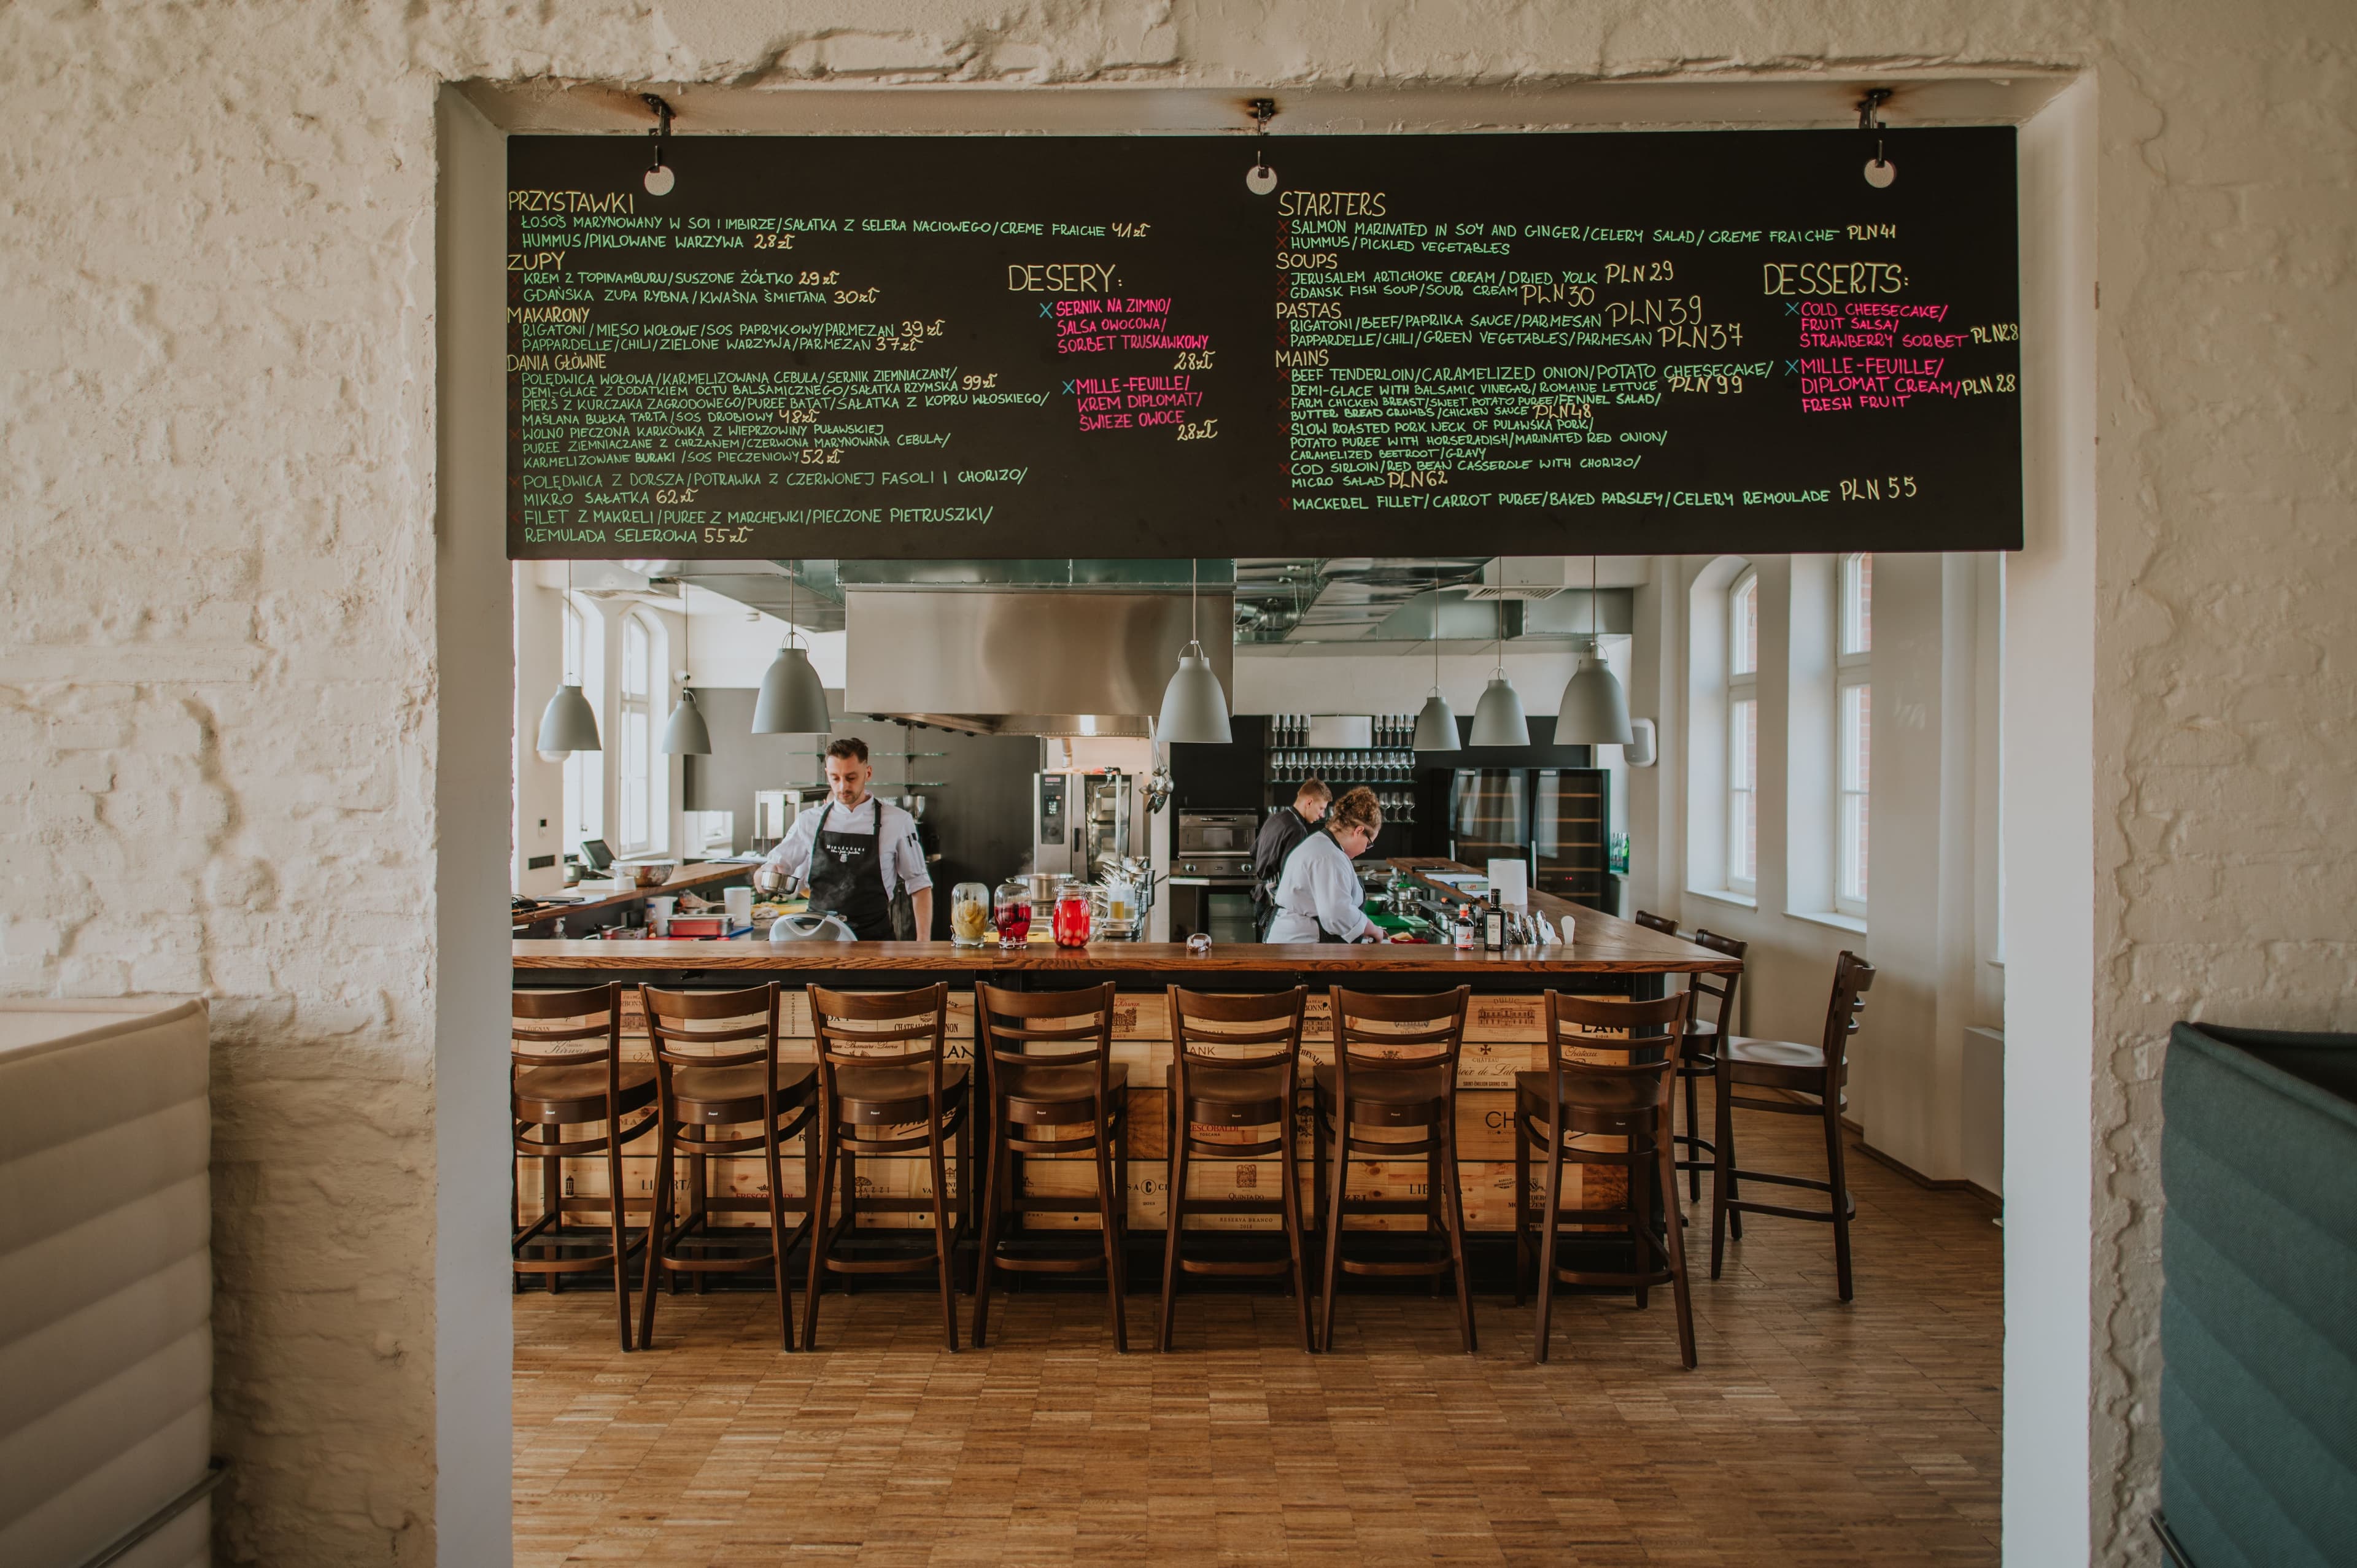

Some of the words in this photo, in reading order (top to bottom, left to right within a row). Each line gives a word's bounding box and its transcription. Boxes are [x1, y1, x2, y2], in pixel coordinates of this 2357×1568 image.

[509, 190, 633, 214] PRZYSTAWKI
[1279, 191, 1385, 216] STARTERS
[574, 216, 662, 228] MARYNOWANY
[670, 218, 679, 229] W
[688, 218, 710, 229] SOI
[718, 220, 719, 228] I
[844, 220, 854, 231] Z
[862, 219, 906, 231] SELERA
[1053, 224, 1105, 236] FRAICHE
[1292, 220, 1345, 234] SALMON
[1355, 223, 1426, 236] MARINATED
[1436, 224, 1447, 236] IN
[1456, 224, 1483, 235] SOY
[1492, 225, 1516, 236] AND
[1770, 230, 1839, 242] FRAICHE
[676, 236, 743, 248] WARZYWA
[1422, 242, 1509, 255] VEGETABLES
[506, 251, 565, 271] ZUPY
[1277, 252, 1337, 269] SOUPS
[524, 272, 559, 284] KREM
[741, 269, 793, 284] ŻÓŁTKO
[1008, 264, 1122, 292] DESERY:
[1291, 271, 1365, 285] JERUSALEM
[1374, 271, 1442, 282] ARTICHOKE
[1563, 271, 1597, 284] YOLK
[1764, 262, 1908, 295] DESSERTS:
[524, 287, 594, 301] GDAŃSKA
[605, 290, 637, 301] ZUPA
[765, 290, 826, 303] ŚMIETANA
[1291, 287, 1343, 298] GDANSK
[1350, 285, 1376, 295] FISH
[1473, 285, 1517, 295] CREAM
[506, 306, 590, 324] MAKARONY
[1056, 300, 1102, 316] SERNIK
[1107, 298, 1121, 312] NA
[1277, 303, 1341, 319] PASTAS
[1802, 302, 1836, 315] COLD
[1057, 319, 1096, 336] SALSA
[1802, 317, 1844, 330] FRUIT
[1058, 336, 1116, 353] SORBET
[1121, 335, 1208, 349] TRUSKAWKOWY
[1800, 333, 1892, 347] STRAWBERRY
[1903, 334, 1968, 347] SORBET
[506, 355, 549, 371] DANIA
[1276, 349, 1328, 368] MAINS
[522, 373, 594, 386] POLĘDWICA
[1292, 369, 1323, 382] BEEF
[523, 387, 597, 398] DEMI-GLACE
[604, 387, 613, 396] Z
[617, 386, 687, 395] DODATKIEM
[697, 385, 727, 395] OCTU
[905, 380, 958, 393] RZYMSKA
[1291, 385, 1373, 396] DEMI-GLACE
[1380, 385, 1409, 395] WITH
[1415, 385, 1474, 395] BALSAMIC
[1603, 380, 1657, 392] LETTUCE
[1802, 377, 1889, 393] DIPLOMAT
[564, 400, 571, 410] Z
[578, 399, 642, 410] KURCZAKA
[907, 397, 916, 407] Z
[926, 395, 967, 406] KOPRU
[1078, 396, 1121, 412] KREM
[1291, 398, 1323, 409] FARM
[1328, 398, 1378, 407] CHICKEN
[1473, 397, 1514, 406] POTATO
[1802, 396, 1852, 412] FRESH
[1860, 395, 1910, 407] FRUIT
[586, 414, 625, 424] BUŁKA
[708, 412, 773, 422] DROBIOWY
[1139, 411, 1184, 427] OWOCE
[1291, 409, 1338, 420] BUTTER
[1344, 409, 1383, 417] BREAD
[1495, 406, 1529, 415] SAUCE
[523, 428, 563, 439] WOLNO
[570, 427, 630, 438] PIECZONA
[714, 427, 722, 436] Z
[729, 425, 807, 436] WIEPRZOWINY
[815, 424, 883, 435] PUŁAWSKIEJ
[1291, 423, 1326, 435] SLOW
[1333, 423, 1390, 434] ROASTED
[1395, 422, 1426, 433] PORK
[1431, 422, 1465, 431] NECK
[1473, 420, 1487, 430] OF
[1493, 420, 1552, 430] PULAWSKA
[524, 442, 559, 454] PUREE
[569, 439, 652, 451] ZIEMNIACZANE
[660, 439, 668, 447] Z
[815, 436, 889, 447] MARYNOWANA
[1290, 437, 1336, 449] POTATO
[1342, 437, 1381, 447] PUREE
[1388, 436, 1418, 446] WITH
[1587, 429, 1611, 442] RED
[524, 454, 630, 468] KARMELIZOWANE
[718, 452, 799, 462] PIECZENIOWY
[1291, 450, 1372, 460] CARAMELIZED
[1291, 463, 1323, 475] COD
[1417, 460, 1452, 471] BEAN
[1458, 460, 1532, 471] CASSEROLE
[1540, 458, 1571, 468] WITH
[524, 474, 602, 490] POLĘDWICA
[613, 474, 621, 485] Z
[770, 474, 777, 484] Z
[787, 473, 874, 485] CZERWONEJ
[883, 471, 933, 484] FASOLI
[944, 471, 946, 484] I
[1292, 477, 1333, 487] MICRO
[1343, 476, 1385, 486] SALAD
[524, 493, 573, 506] MIKRO
[585, 492, 649, 504] SAŁATKA
[1293, 498, 1368, 509] MACKEREL
[1743, 491, 1830, 504] REMOULADE
[525, 510, 569, 524] FILET
[579, 510, 588, 522] Z
[710, 511, 721, 523] Z
[525, 528, 605, 542] REMULADA
[615, 528, 697, 543] SELEROWA
